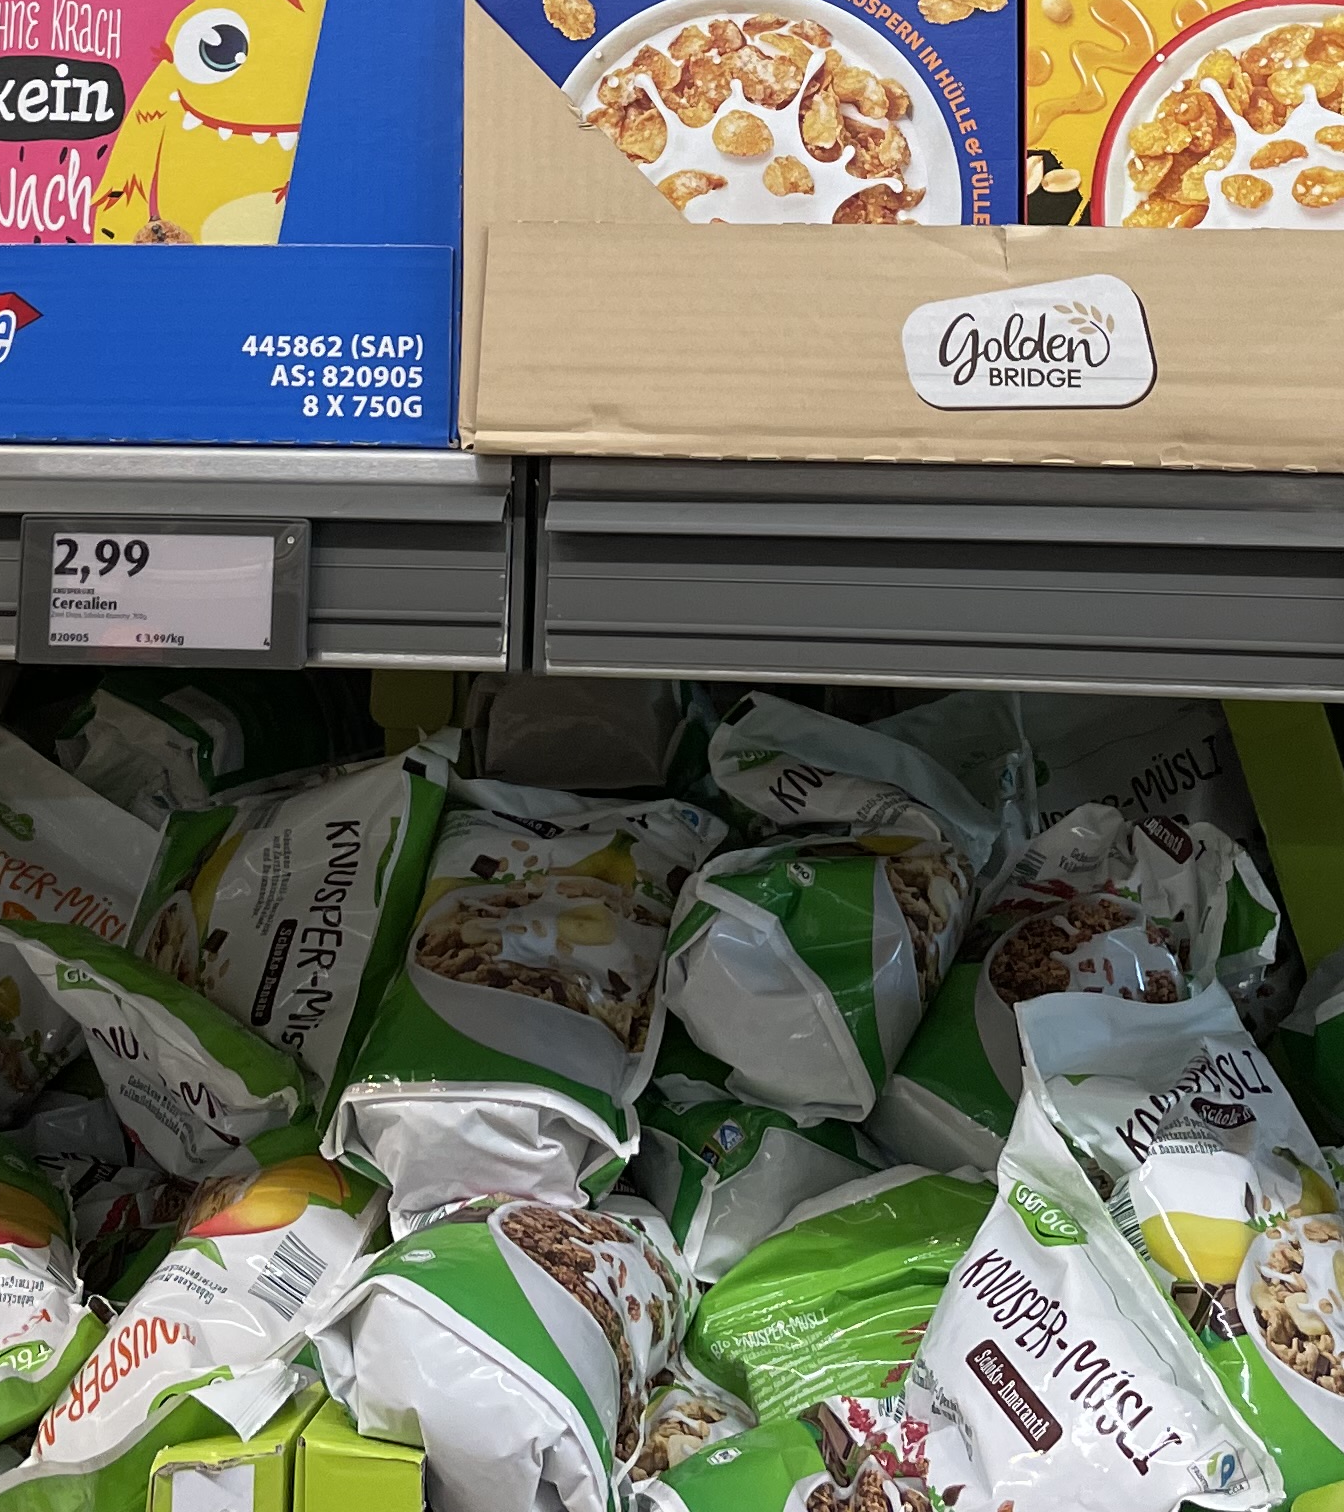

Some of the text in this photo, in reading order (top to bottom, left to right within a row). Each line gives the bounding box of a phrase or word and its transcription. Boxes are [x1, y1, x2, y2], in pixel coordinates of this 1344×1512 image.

[918, 45, 943, 73] IN
[934, 68, 978, 135] HÜLLE
[969, 160, 994, 226] FÜLLE
[241, 333, 424, 362] 445862 (SAP)
[939, 312, 1111, 385] Golden
[270, 364, 424, 389] AS: 820905
[989, 367, 1082, 389] BRIDGE
[303, 395, 319, 418] 8
[351, 396, 424, 419] 750G
[54, 538, 150, 584] 2,99
[53, 597, 117, 610] Cerealien
[51, 633, 89, 643] 820905
[959, 1248, 1182, 1476] KNUSPER-MÜSLI
[973, 1348, 1053, 1442] Schoko-Amaranth
